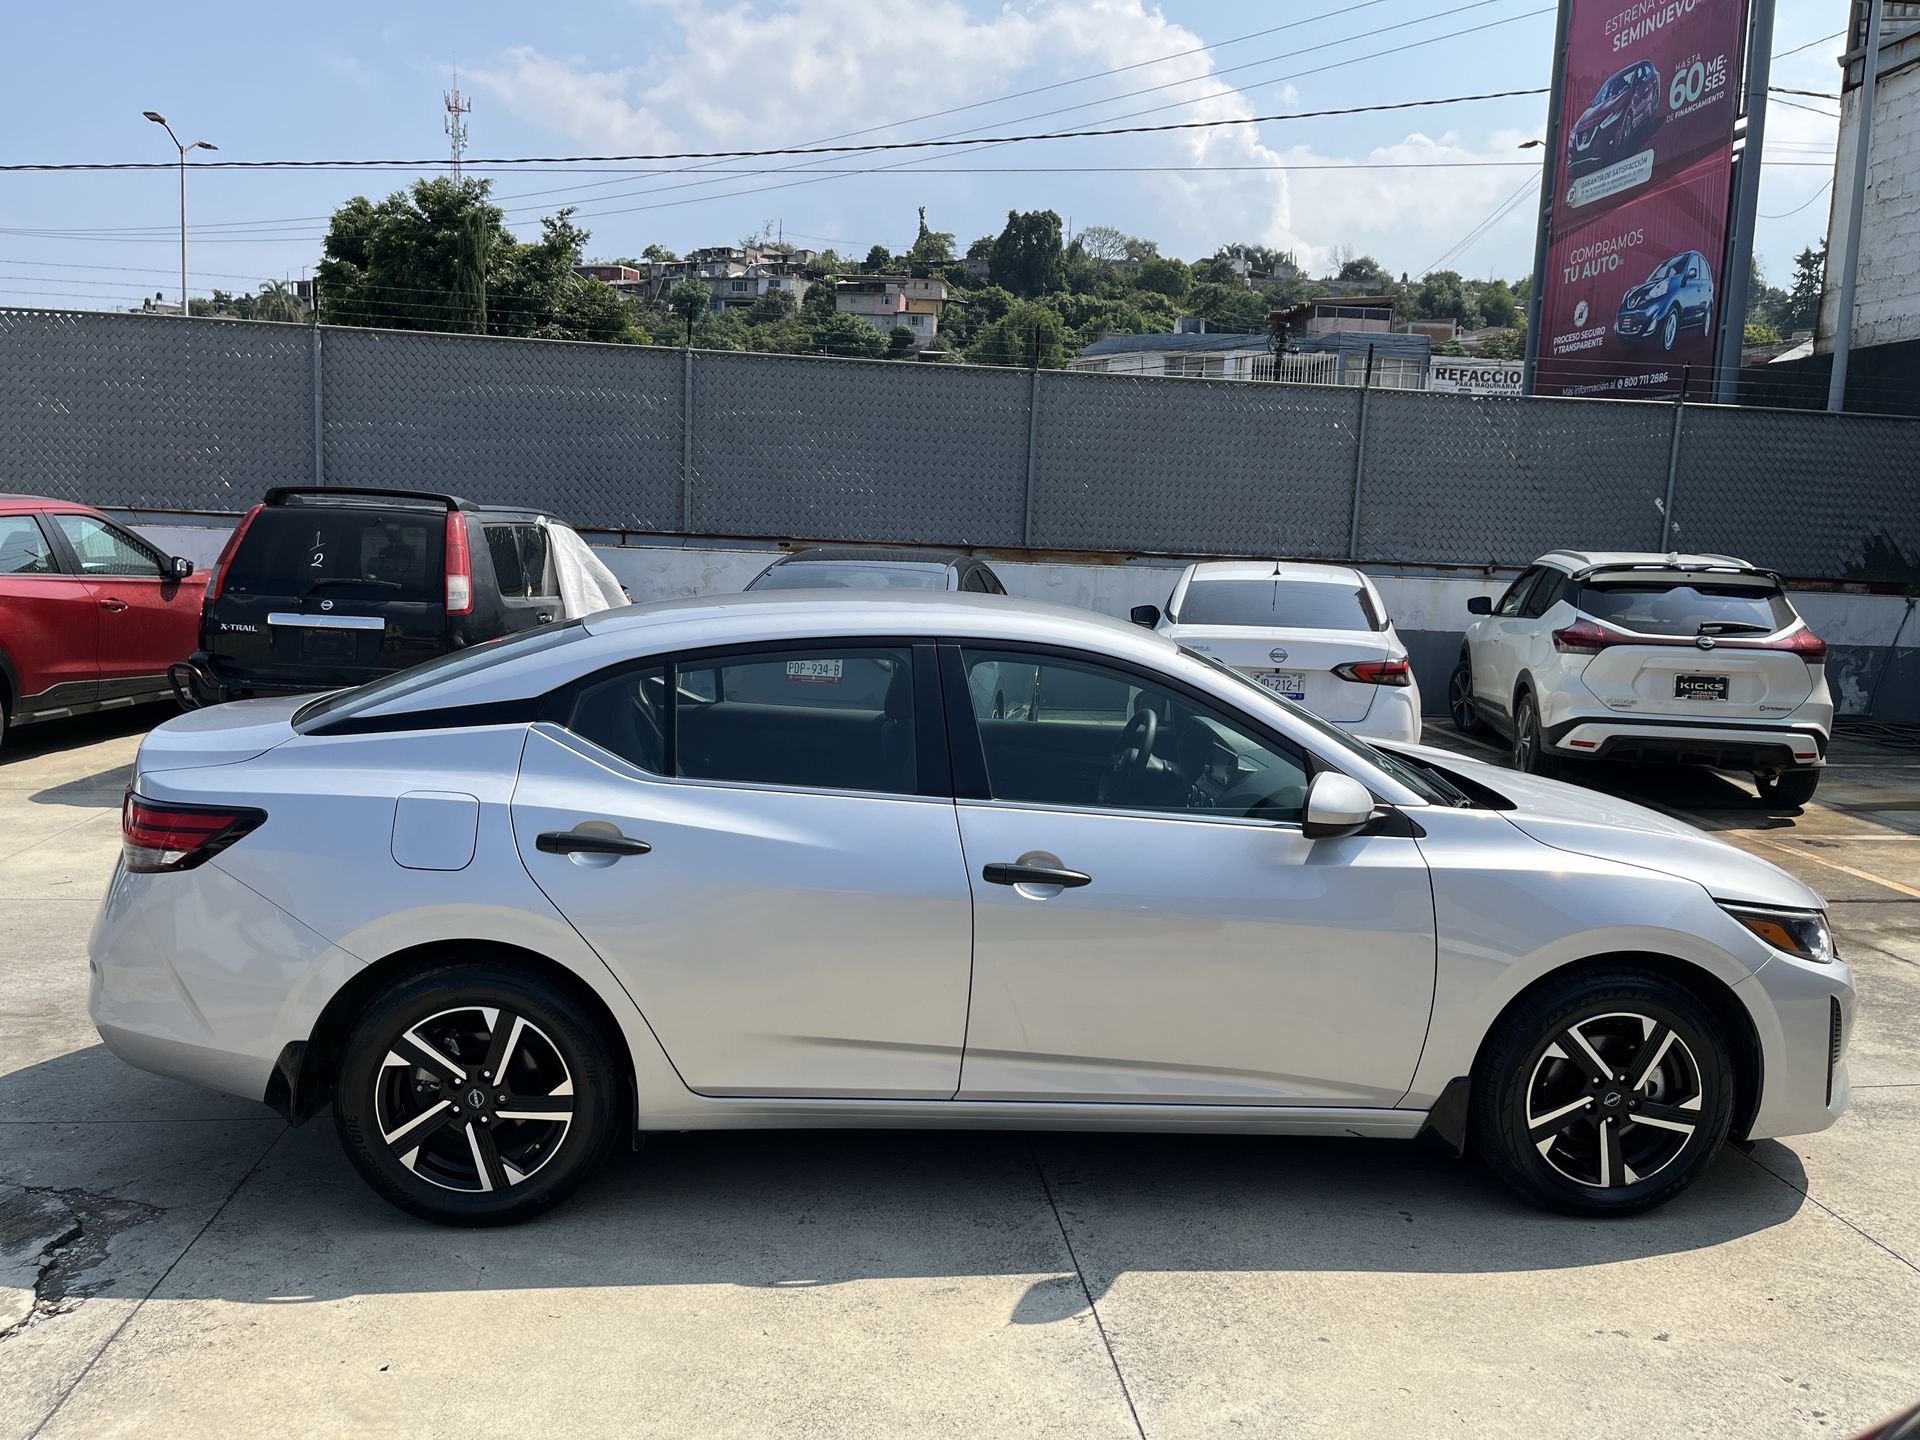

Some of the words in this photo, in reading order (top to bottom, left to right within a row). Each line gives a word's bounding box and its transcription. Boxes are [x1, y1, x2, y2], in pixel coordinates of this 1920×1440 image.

[1605, 0, 1656, 36] ESTRENA
[1675, 53, 1701, 72] HASTA
[1706, 54, 1728, 75] ME-
[1669, 61, 1705, 110] 60
[1704, 69, 1726, 92] SES
[1666, 113, 1675, 123] DE
[1675, 90, 1725, 119] FINANCIAMIENTO
[1570, 228, 1644, 265] COMPRAMOS
[1563, 265, 1579, 285] TU
[1581, 253, 1619, 280] AUTO
[1553, 331, 1580, 346] PROCESO
[1581, 326, 1606, 339] SEGURO
[1553, 347, 1558, 355] Y
[1558, 337, 1604, 354] TRANSPARENTE
[1475, 382, 1517, 390] MAQUINARIA
[1561, 386, 1574, 396] Más
[1574, 380, 1609, 395] información
[1624, 376, 1638, 388] 800
[1639, 374, 1649, 385] 711
[1650, 371, 1669, 384] 2886
[311, 553, 324, 568] 2
[220, 623, 258, 633] X-TRAIL
[788, 662, 840, 676] PDP-934-B
[1680, 682, 1725, 691] KICKS
